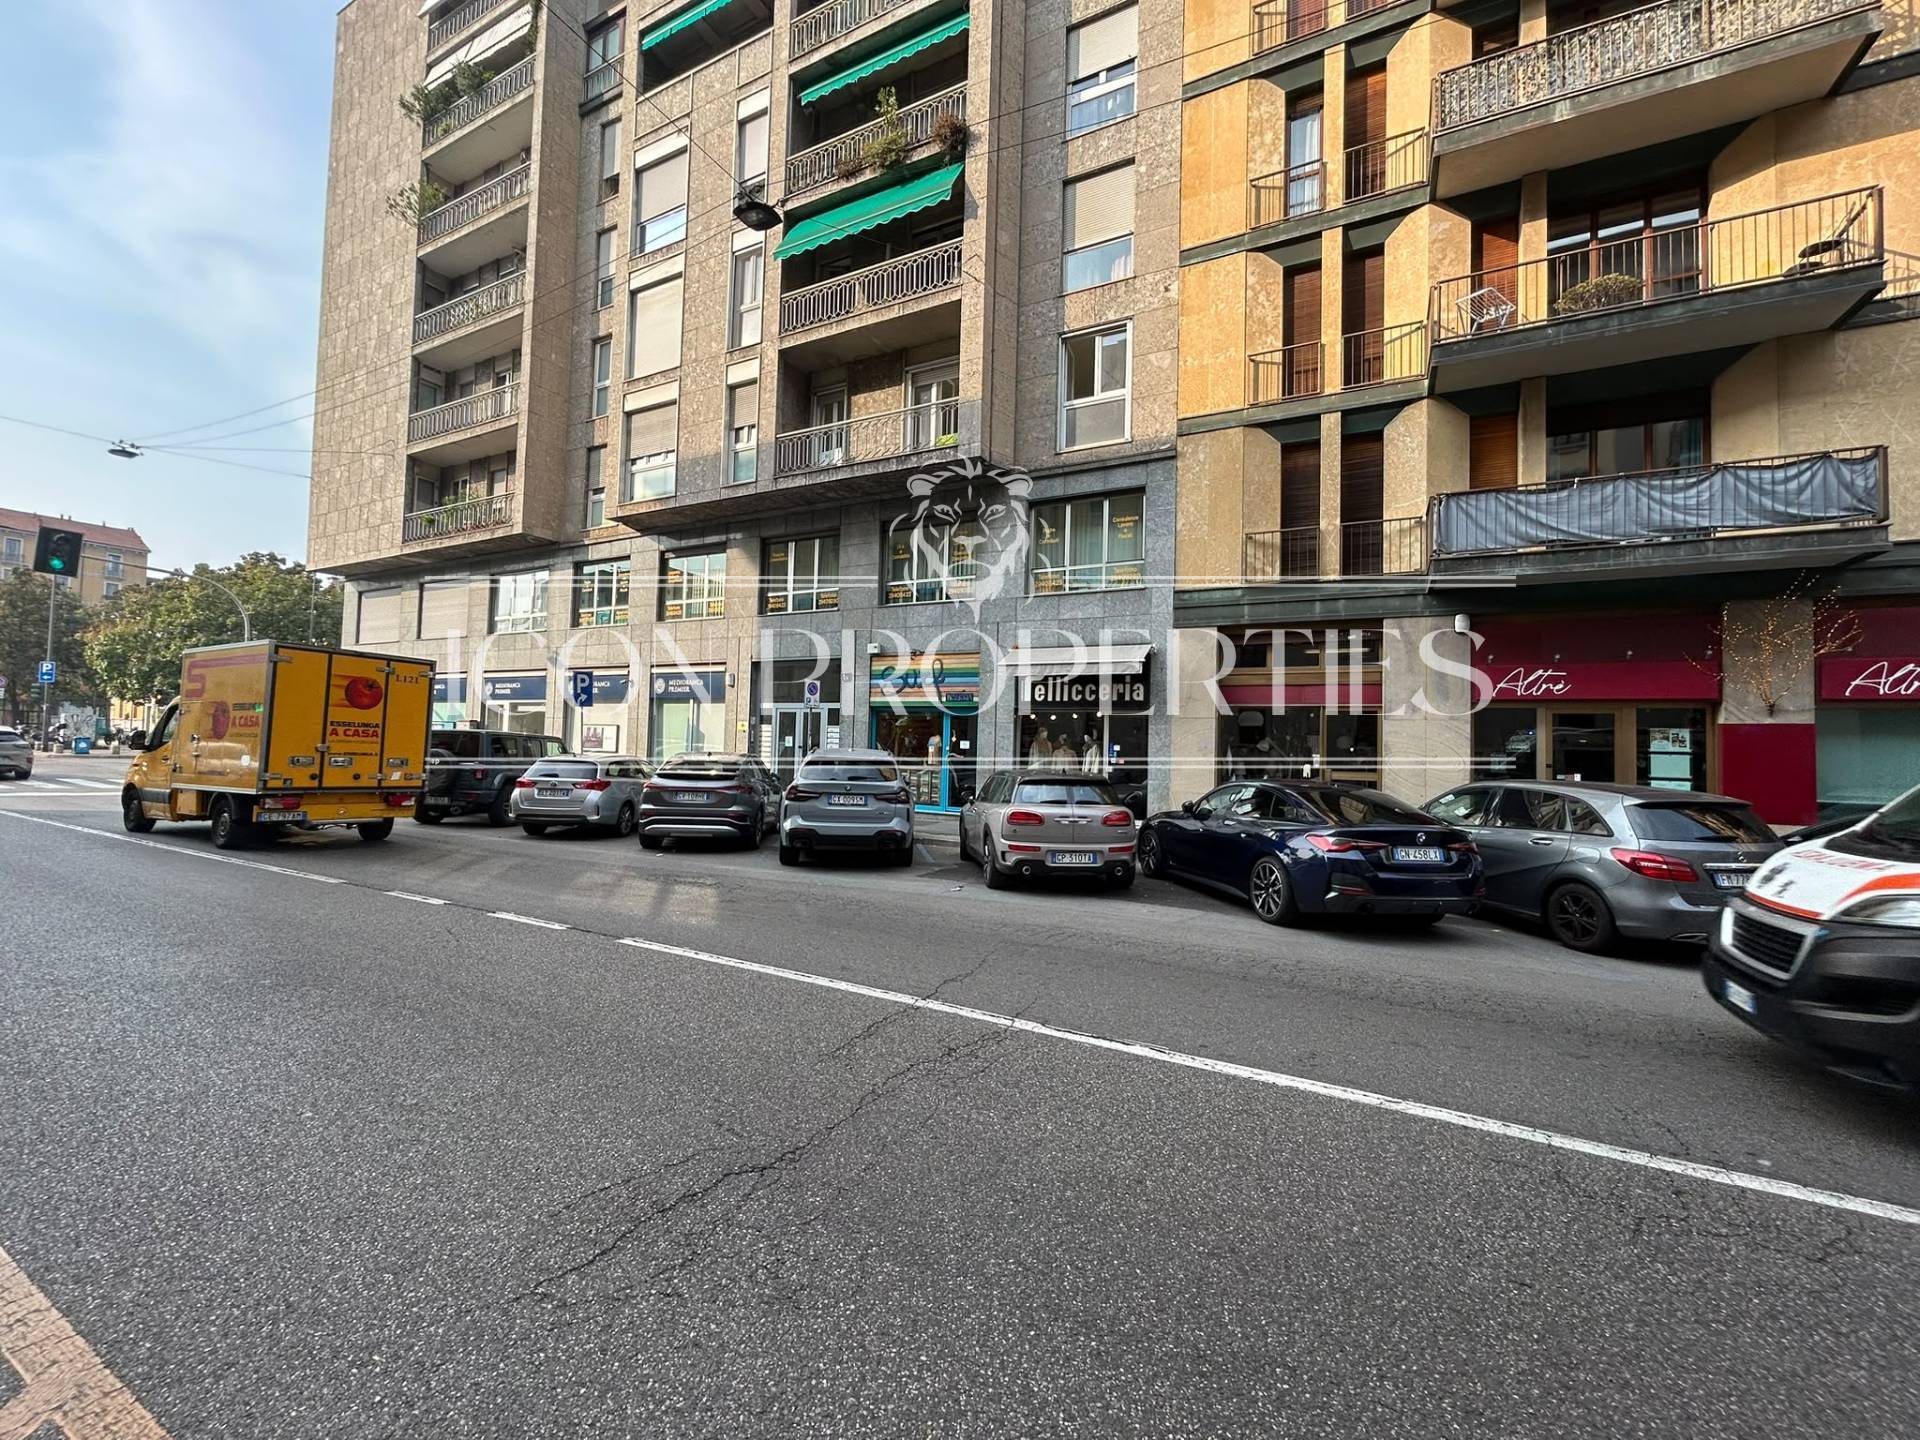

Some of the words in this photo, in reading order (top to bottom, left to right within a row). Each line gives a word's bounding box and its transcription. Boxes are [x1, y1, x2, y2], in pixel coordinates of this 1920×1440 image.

[42, 663, 53, 673] P
[577, 674, 590, 693] P
[329, 728, 339, 737] A
[343, 728, 380, 738] CASA
